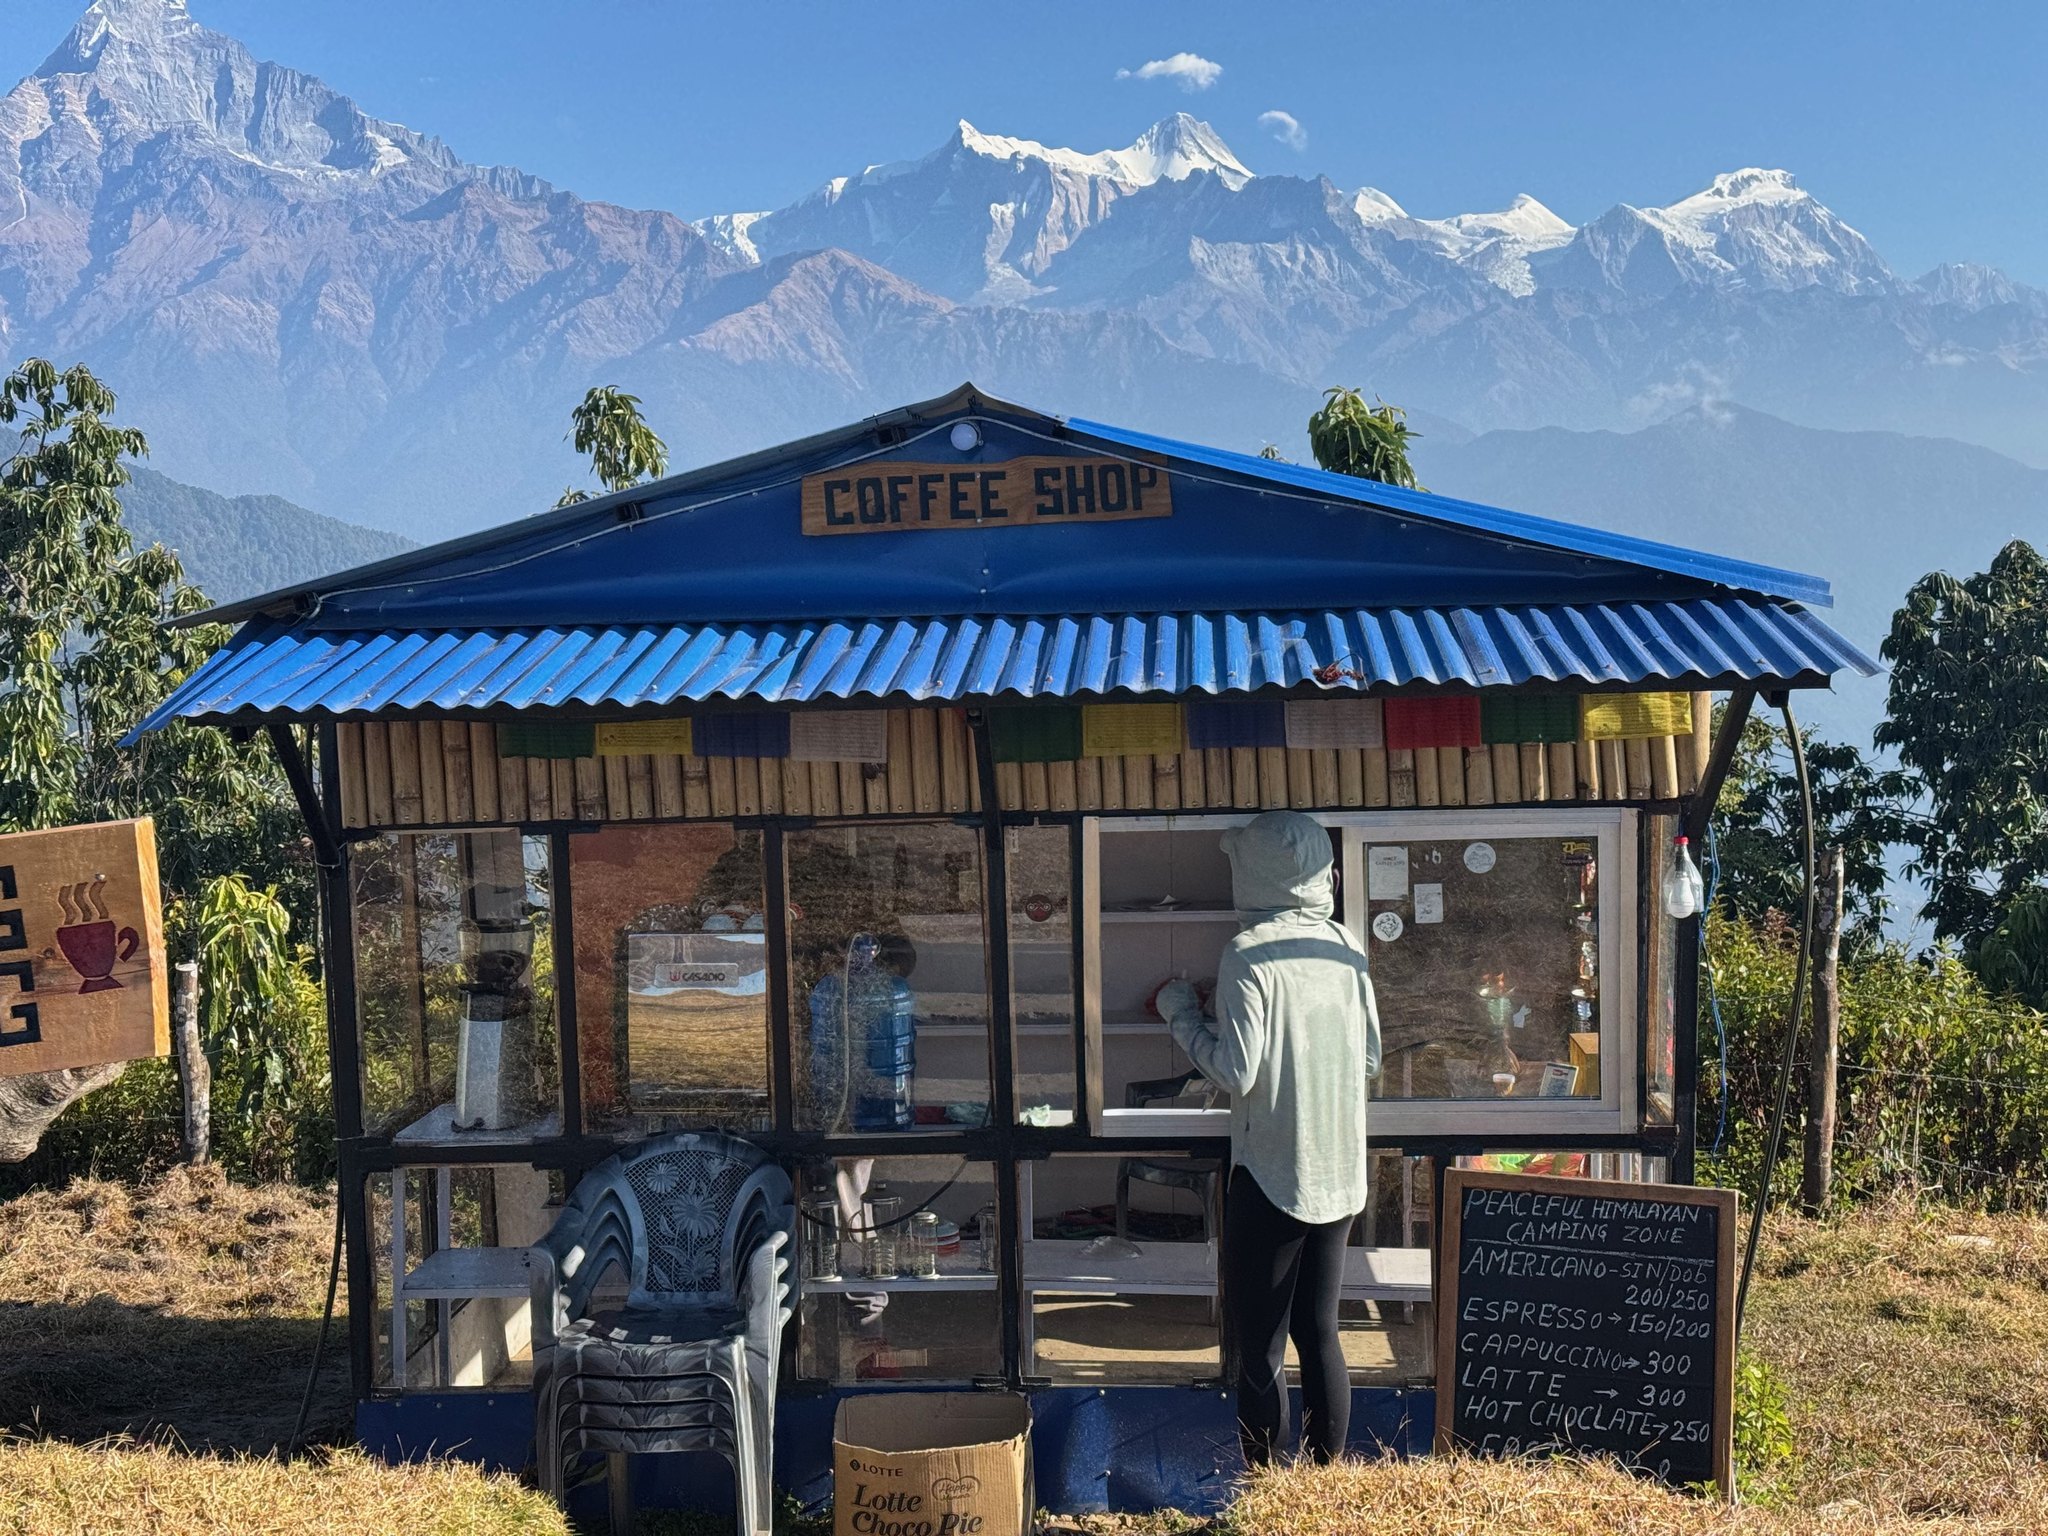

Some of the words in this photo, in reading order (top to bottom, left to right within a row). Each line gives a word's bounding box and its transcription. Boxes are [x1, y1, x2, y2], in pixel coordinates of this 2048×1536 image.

[823, 471, 1008, 526] COFFEE
[1033, 463, 1157, 516] SHOP
[682, 972, 726, 981] CASADIO
[1463, 1189, 1584, 1220] PEACEFUL
[1592, 1198, 1701, 1224] HIMALAYAN
[1506, 1220, 1608, 1244] CAMPING
[1622, 1225, 1686, 1244] ZONE
[1624, 1283, 1710, 1311] 200/250
[1463, 1297, 1601, 1330] ESPRESSO
[1627, 1312, 1711, 1342] 150/200
[1461, 1332, 1622, 1371] CAPPUCCINO
[1642, 1350, 1691, 1376] 300
[1461, 1361, 1567, 1398] LATTE
[1637, 1384, 1686, 1407] 300
[1465, 1395, 1523, 1423] HOT
[1529, 1400, 1656, 1436] CHOCLATE
[1670, 1421, 1711, 1443] 250
[862, 1462, 904, 1477] LOTTE
[853, 1483, 922, 1515] Lotte
[852, 1510, 932, 1536] Choco
[934, 1511, 984, 1536] Pie
